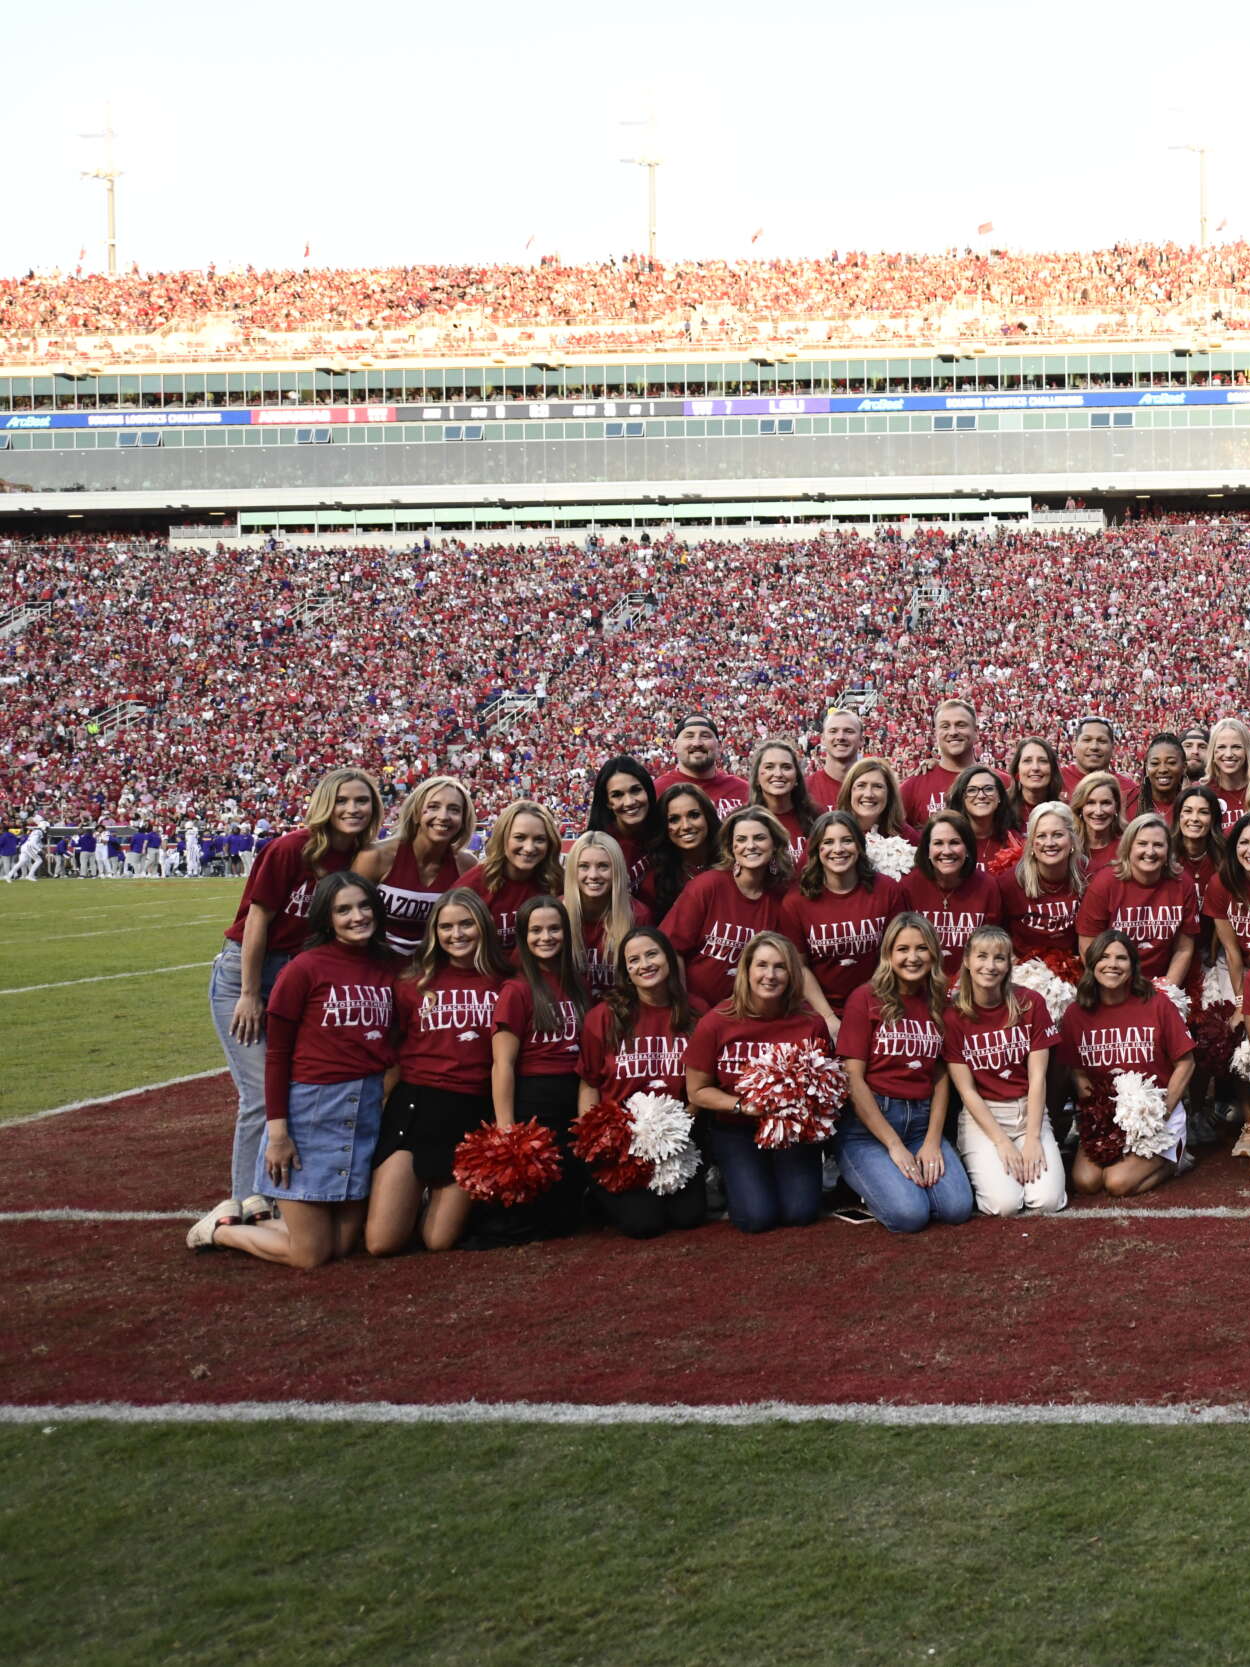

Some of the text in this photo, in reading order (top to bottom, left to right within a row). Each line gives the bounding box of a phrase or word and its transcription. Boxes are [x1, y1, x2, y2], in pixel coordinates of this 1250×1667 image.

[914, 911, 985, 948] LUMNI
[1022, 900, 1081, 932] ALUM
[1113, 904, 1184, 941] ALUMNI
[320, 984, 393, 1027] ALUM
[418, 989, 499, 1033] ALUM
[961, 1023, 1033, 1071] ALUMN
[1079, 1026, 1156, 1067] ALUMNI
